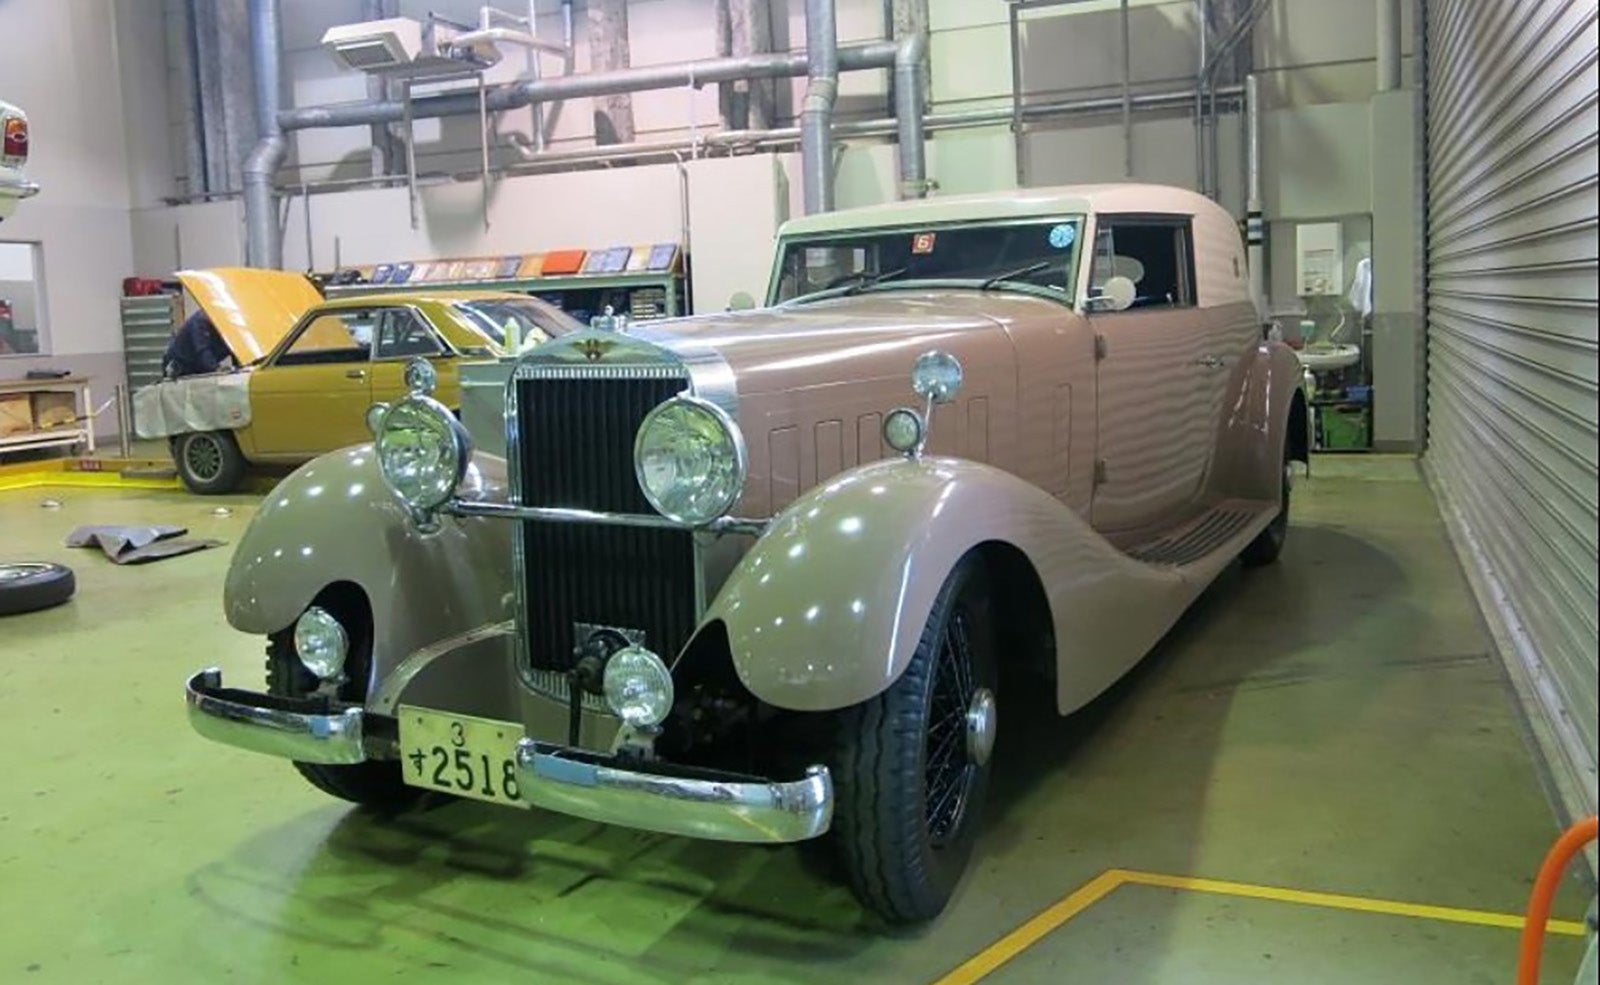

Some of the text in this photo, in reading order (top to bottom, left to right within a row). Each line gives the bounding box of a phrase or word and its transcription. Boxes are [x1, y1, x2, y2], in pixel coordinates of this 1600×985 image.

[451, 722, 465, 747] 3
[409, 746, 521, 800] す 2518
